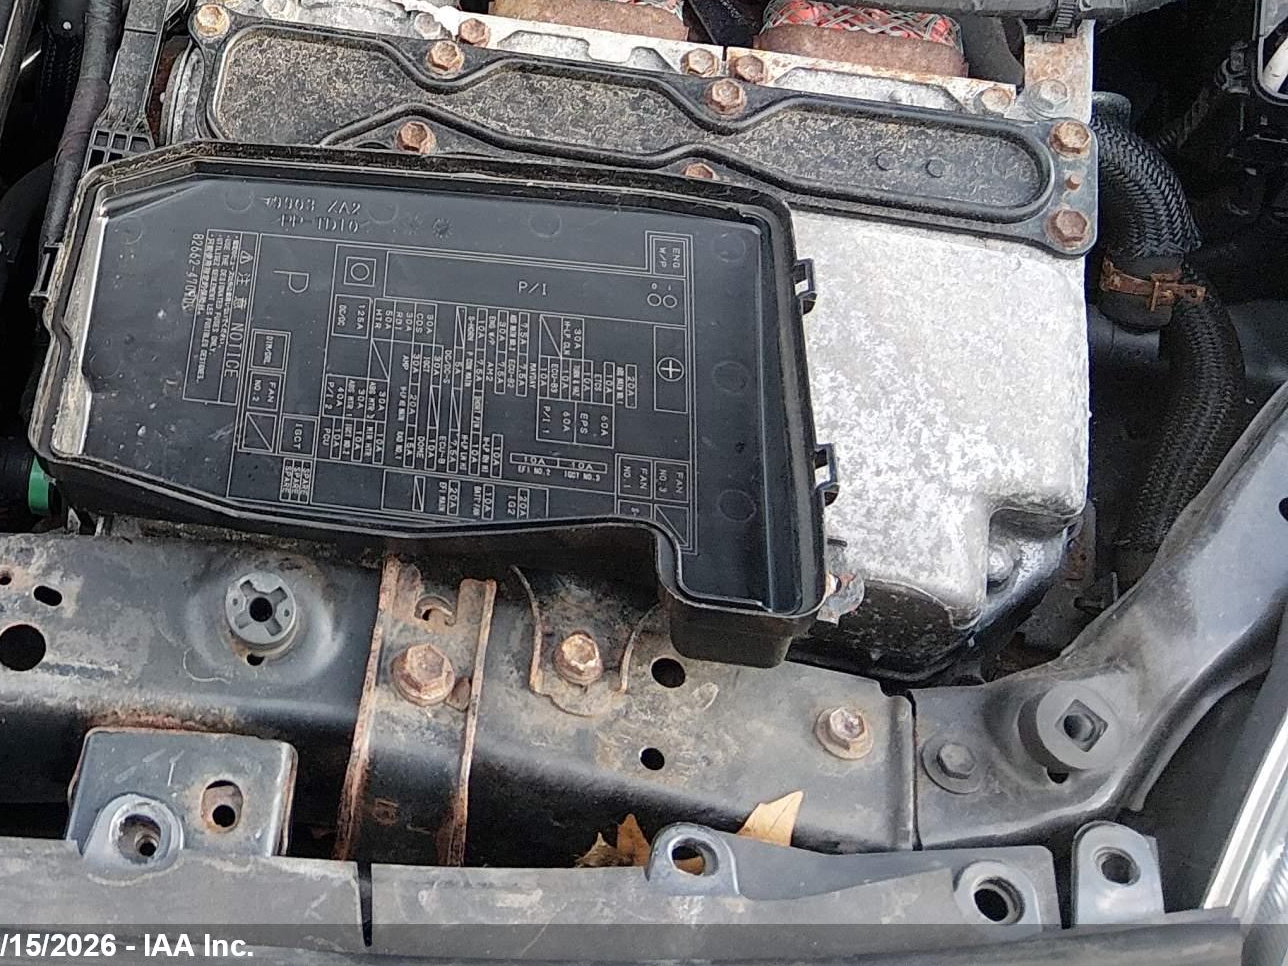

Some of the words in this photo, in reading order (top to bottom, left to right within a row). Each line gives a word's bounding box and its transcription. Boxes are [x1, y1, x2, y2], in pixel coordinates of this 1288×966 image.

[215, 269, 227, 309] DESIGNATED
[273, 271, 309, 293] P
[518, 281, 547, 296] P/I
[212, 312, 222, 332] FUSES
[337, 304, 347, 326] DC/DC
[357, 304, 365, 329] 125A
[520, 323, 528, 344] 7.5A
[224, 322, 244, 378] NOTICE
[263, 336, 274, 364] DIM/DRL
[443, 350, 451, 384] DC/DC-S
[455, 362, 461, 374] 5A
[476, 360, 484, 381] 7.5A
[497, 361, 505, 384] 7.5A
[507, 359, 515, 387] ECU-B2
[518, 364, 526, 386] 7.5A
[253, 380, 261, 402] NO.2
[267, 382, 276, 402] FAN
[326, 381, 334, 397] P/I
[594, 374, 602, 391] ETCS
[336, 387, 344, 406] 40A
[346, 396, 354, 409] MTR
[357, 389, 365, 409] 30A
[367, 398, 375, 411] MTR
[378, 391, 386, 411] 30A
[542, 406, 550, 422] P/I
[580, 413, 588, 434] EPS
[293, 423, 303, 450] IGCT
[323, 428, 331, 445] PCU
[344, 424, 352, 437] IGCT
[364, 443, 372, 456] HTR
[375, 433, 383, 452] 10A
[438, 436, 446, 464] ECU-B
[518, 465, 531, 473] EFI
[524, 457, 545, 465] 10A
[572, 462, 592, 470] 10A
[283, 465, 292, 493] SPARE
[292, 466, 301, 494] SPARE
[301, 467, 309, 495] SPARE
[564, 470, 580, 479] IGCT
[623, 466, 631, 488] NO.1
[640, 468, 648, 490] FAN
[659, 469, 667, 492] NO.3
[675, 472, 683, 493] FAN
[449, 488, 457, 508] 20A
